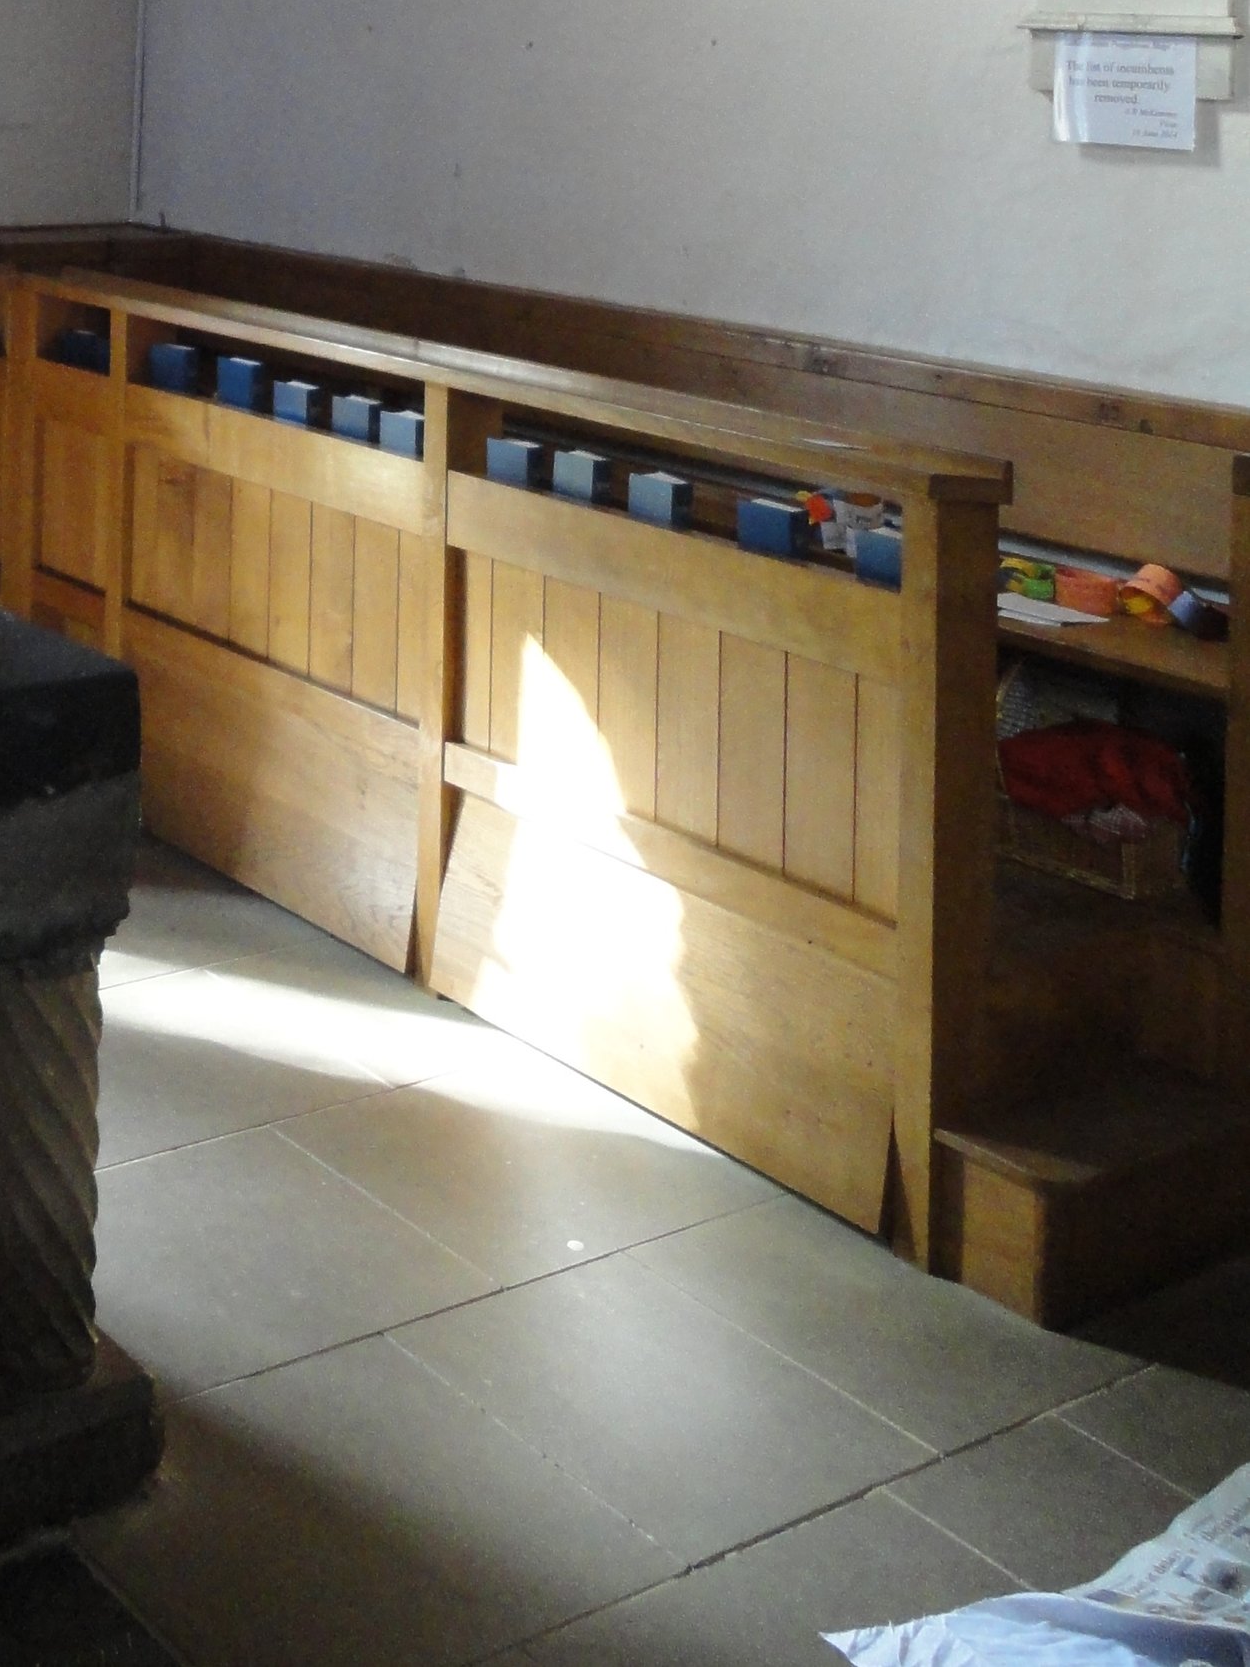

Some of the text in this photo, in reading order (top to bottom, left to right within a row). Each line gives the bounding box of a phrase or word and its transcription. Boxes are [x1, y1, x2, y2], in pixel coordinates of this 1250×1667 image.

[1103, 62, 1114, 73] of
[1086, 77, 1109, 87] been
[1111, 79, 1170, 92] temporarily
